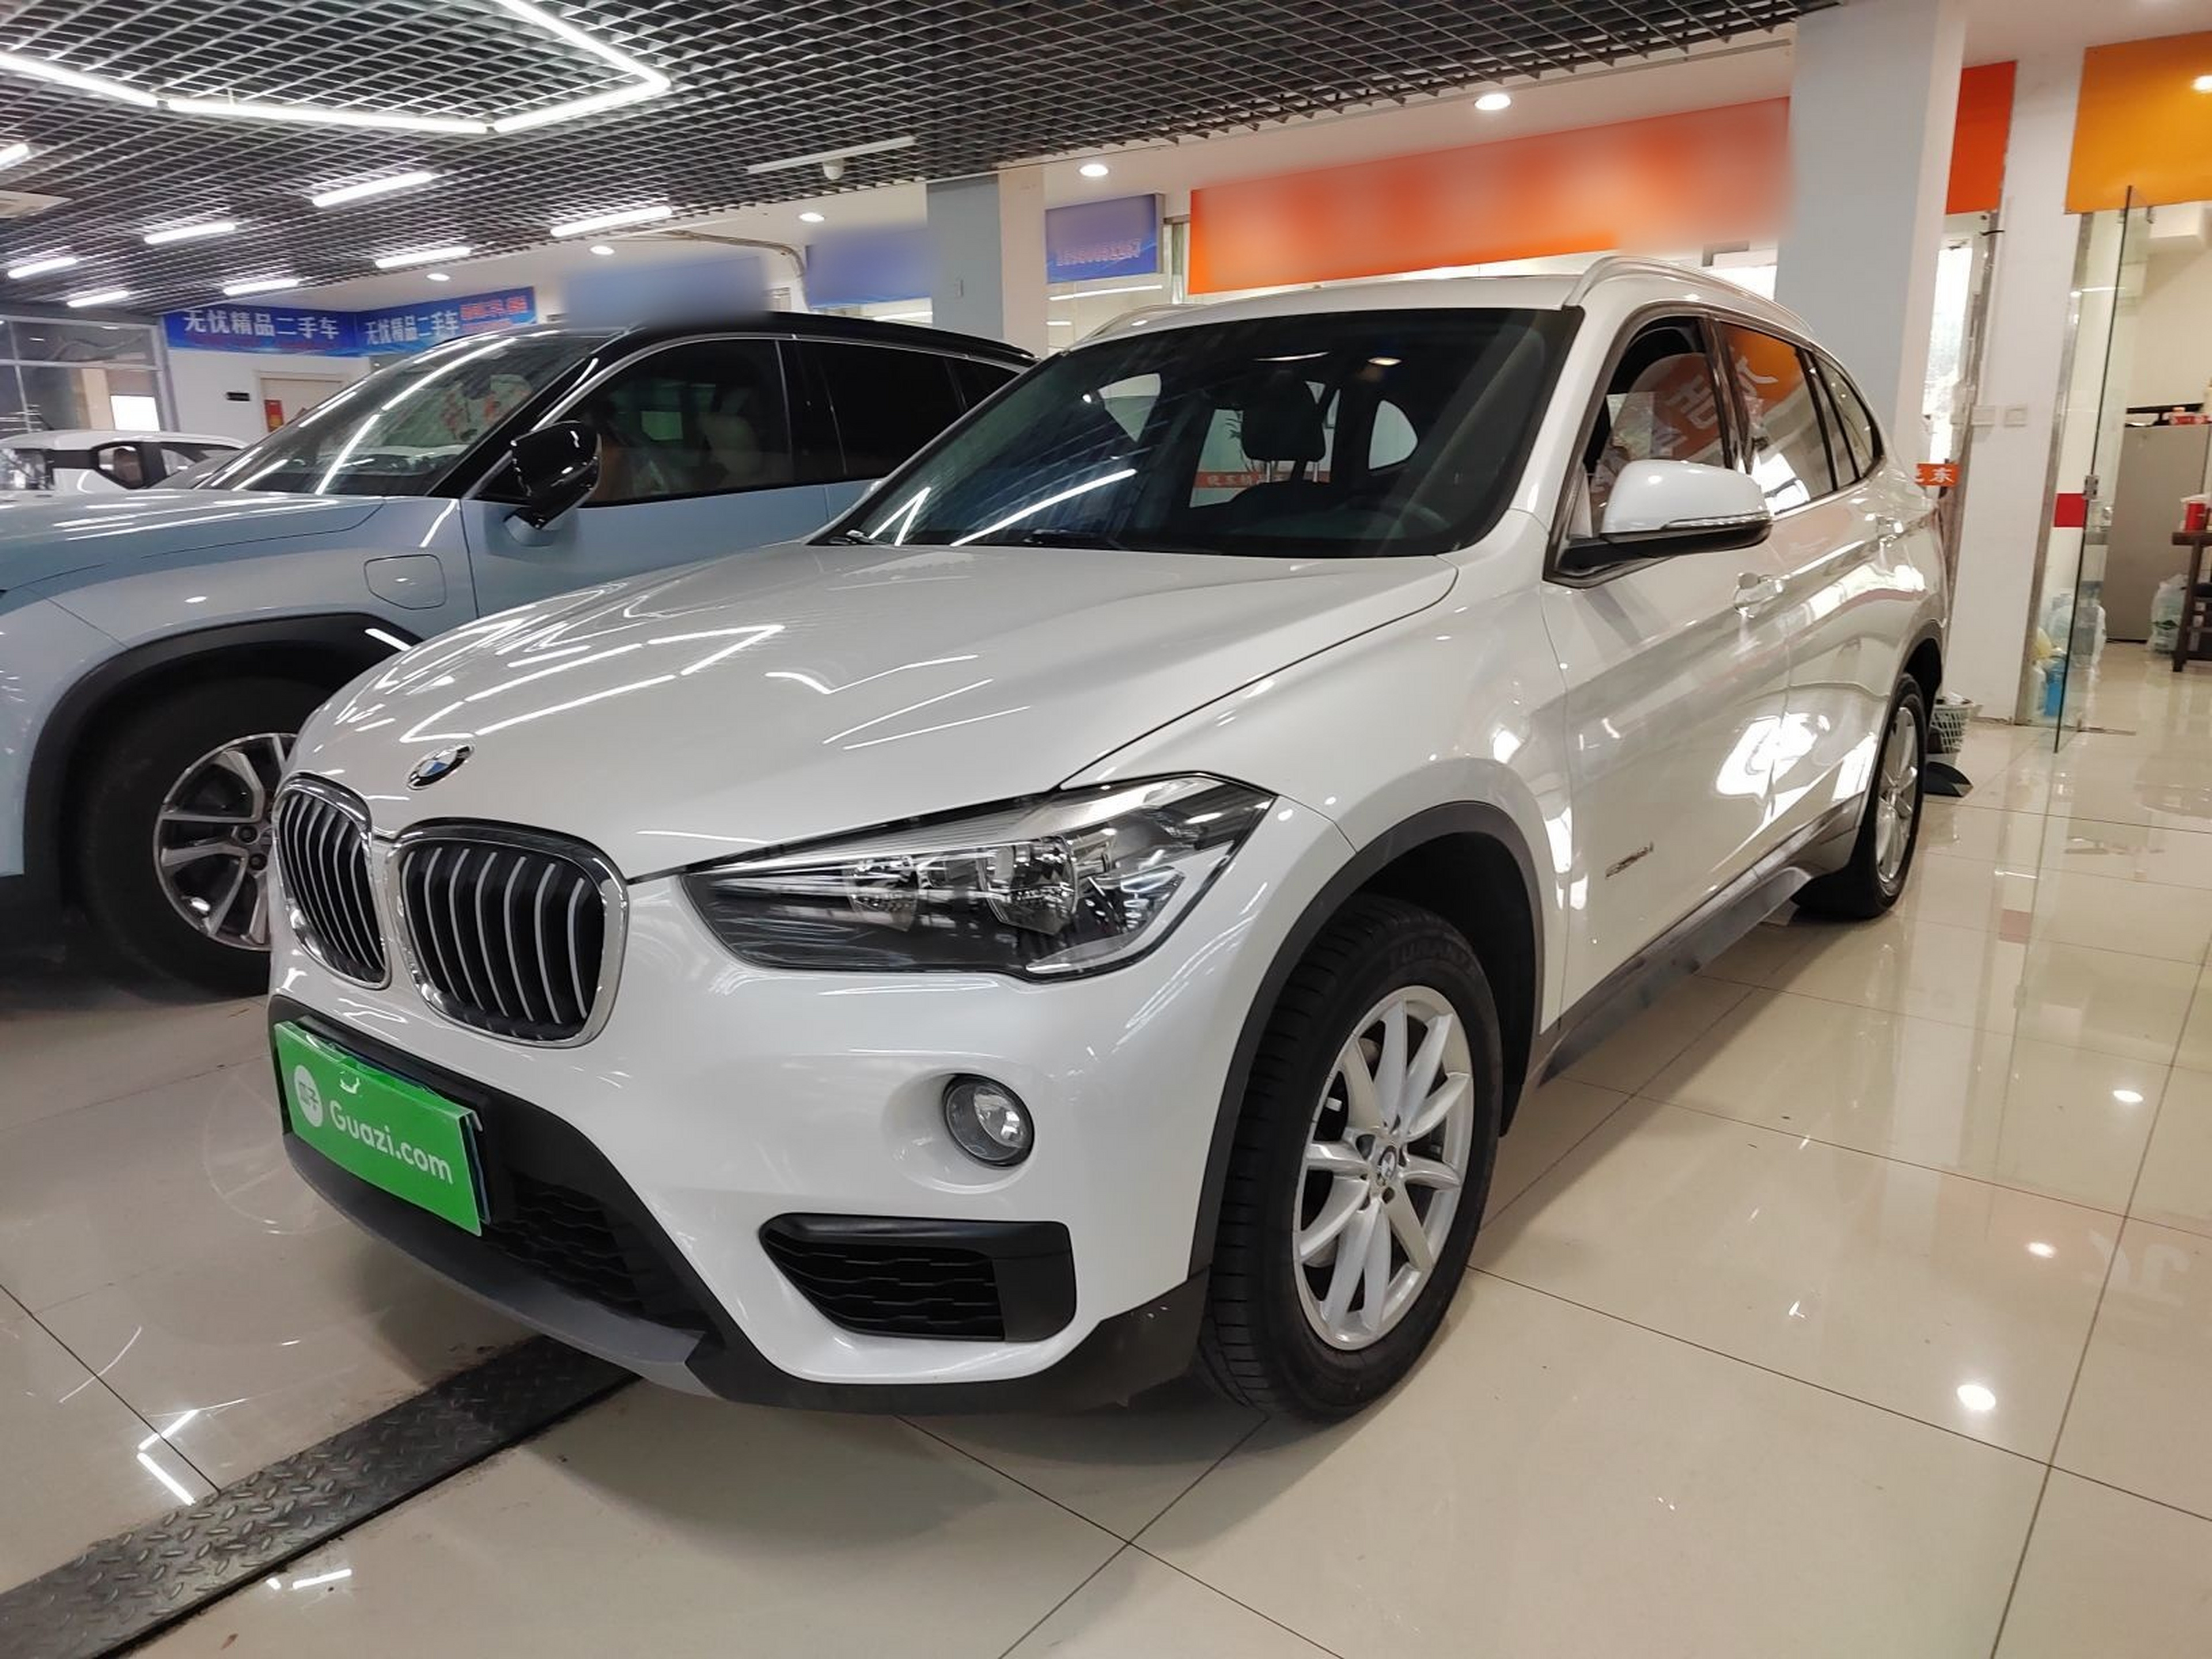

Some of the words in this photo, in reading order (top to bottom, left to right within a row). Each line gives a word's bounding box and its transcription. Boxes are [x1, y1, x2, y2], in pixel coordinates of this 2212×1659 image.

[183, 309, 340, 340] 无忧精品二手车
[365, 310, 459, 344] 无忧精品二手车
[330, 1100, 453, 1185] Guazi.com
